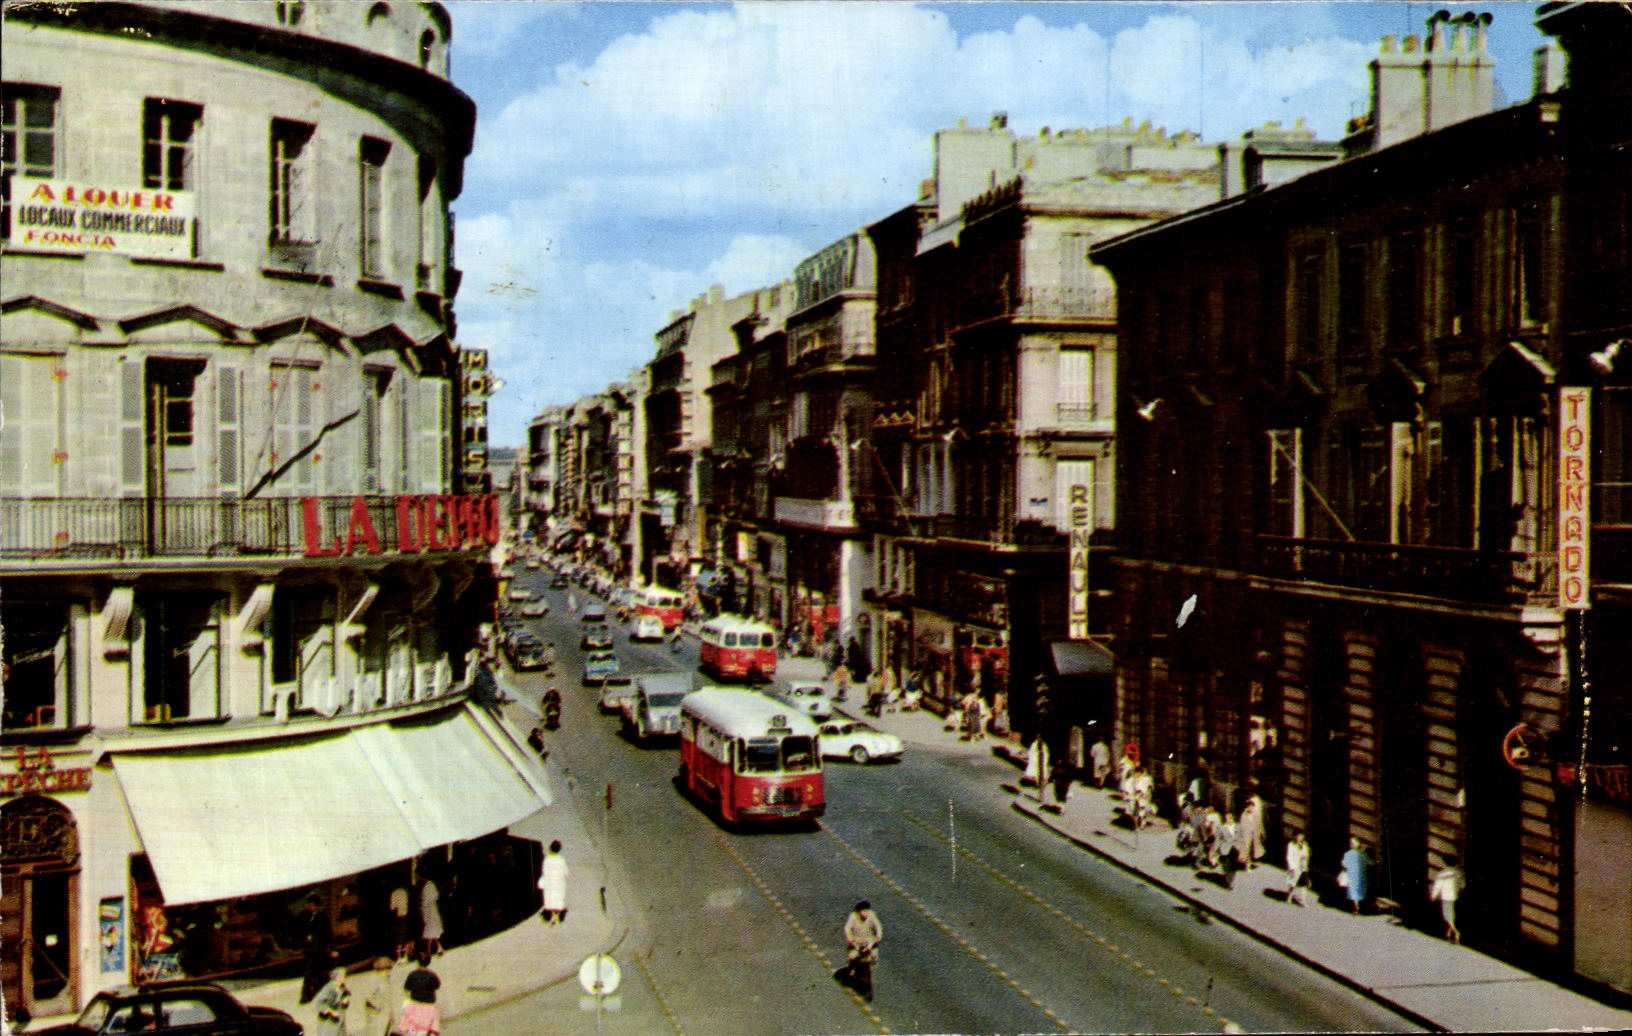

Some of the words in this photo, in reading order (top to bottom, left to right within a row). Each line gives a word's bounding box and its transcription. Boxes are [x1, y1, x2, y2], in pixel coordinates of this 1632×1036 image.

[30, 184, 56, 202] A
[65, 186, 174, 210] LOUER
[18, 204, 76, 228] LOCAUX
[80, 210, 187, 237] COMMERCIAUX
[26, 230, 117, 249] FONCIA
[1562, 391, 1585, 603] TORNADO
[303, 497, 383, 556] LA
[1070, 484, 1089, 638] RENAULT
[17, 746, 55, 769] LA
